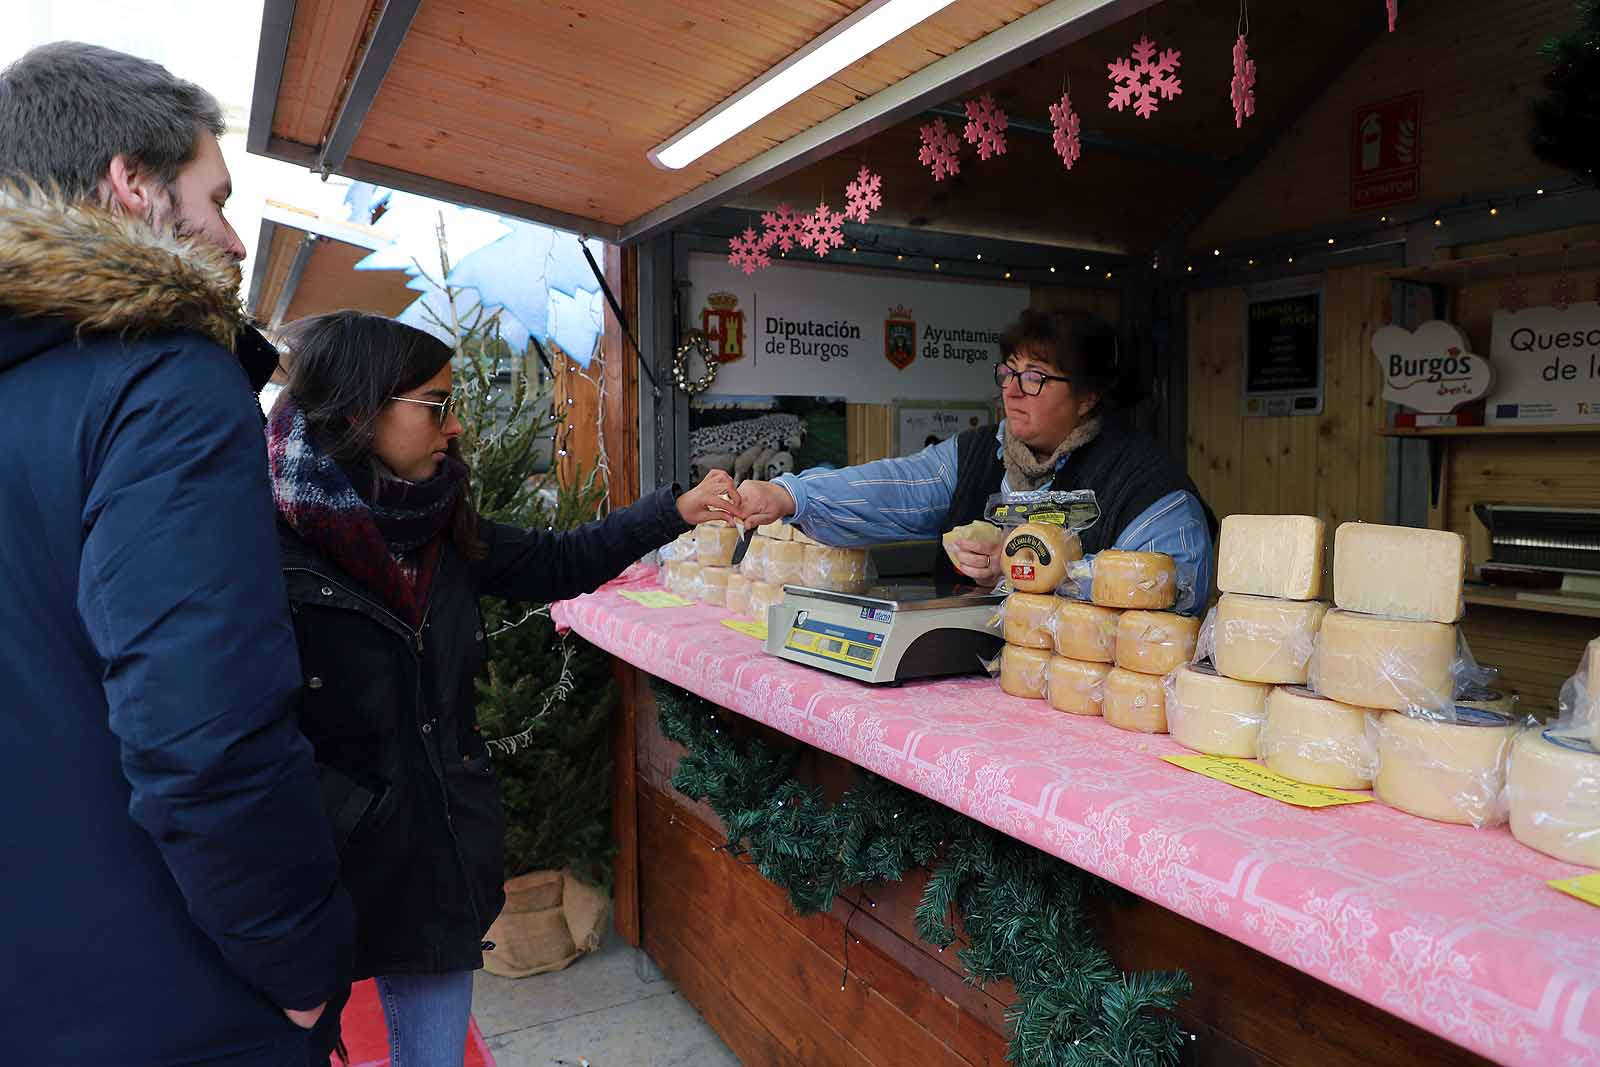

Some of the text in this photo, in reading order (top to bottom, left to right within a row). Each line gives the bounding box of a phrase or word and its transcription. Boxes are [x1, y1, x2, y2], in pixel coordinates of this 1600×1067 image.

[765, 317, 860, 340] Diputación
[765, 336, 848, 361] de Burgos
[923, 342, 988, 364] de Burgos
[1390, 355, 1471, 383] Burgos
[1542, 354, 1600, 381] de l
